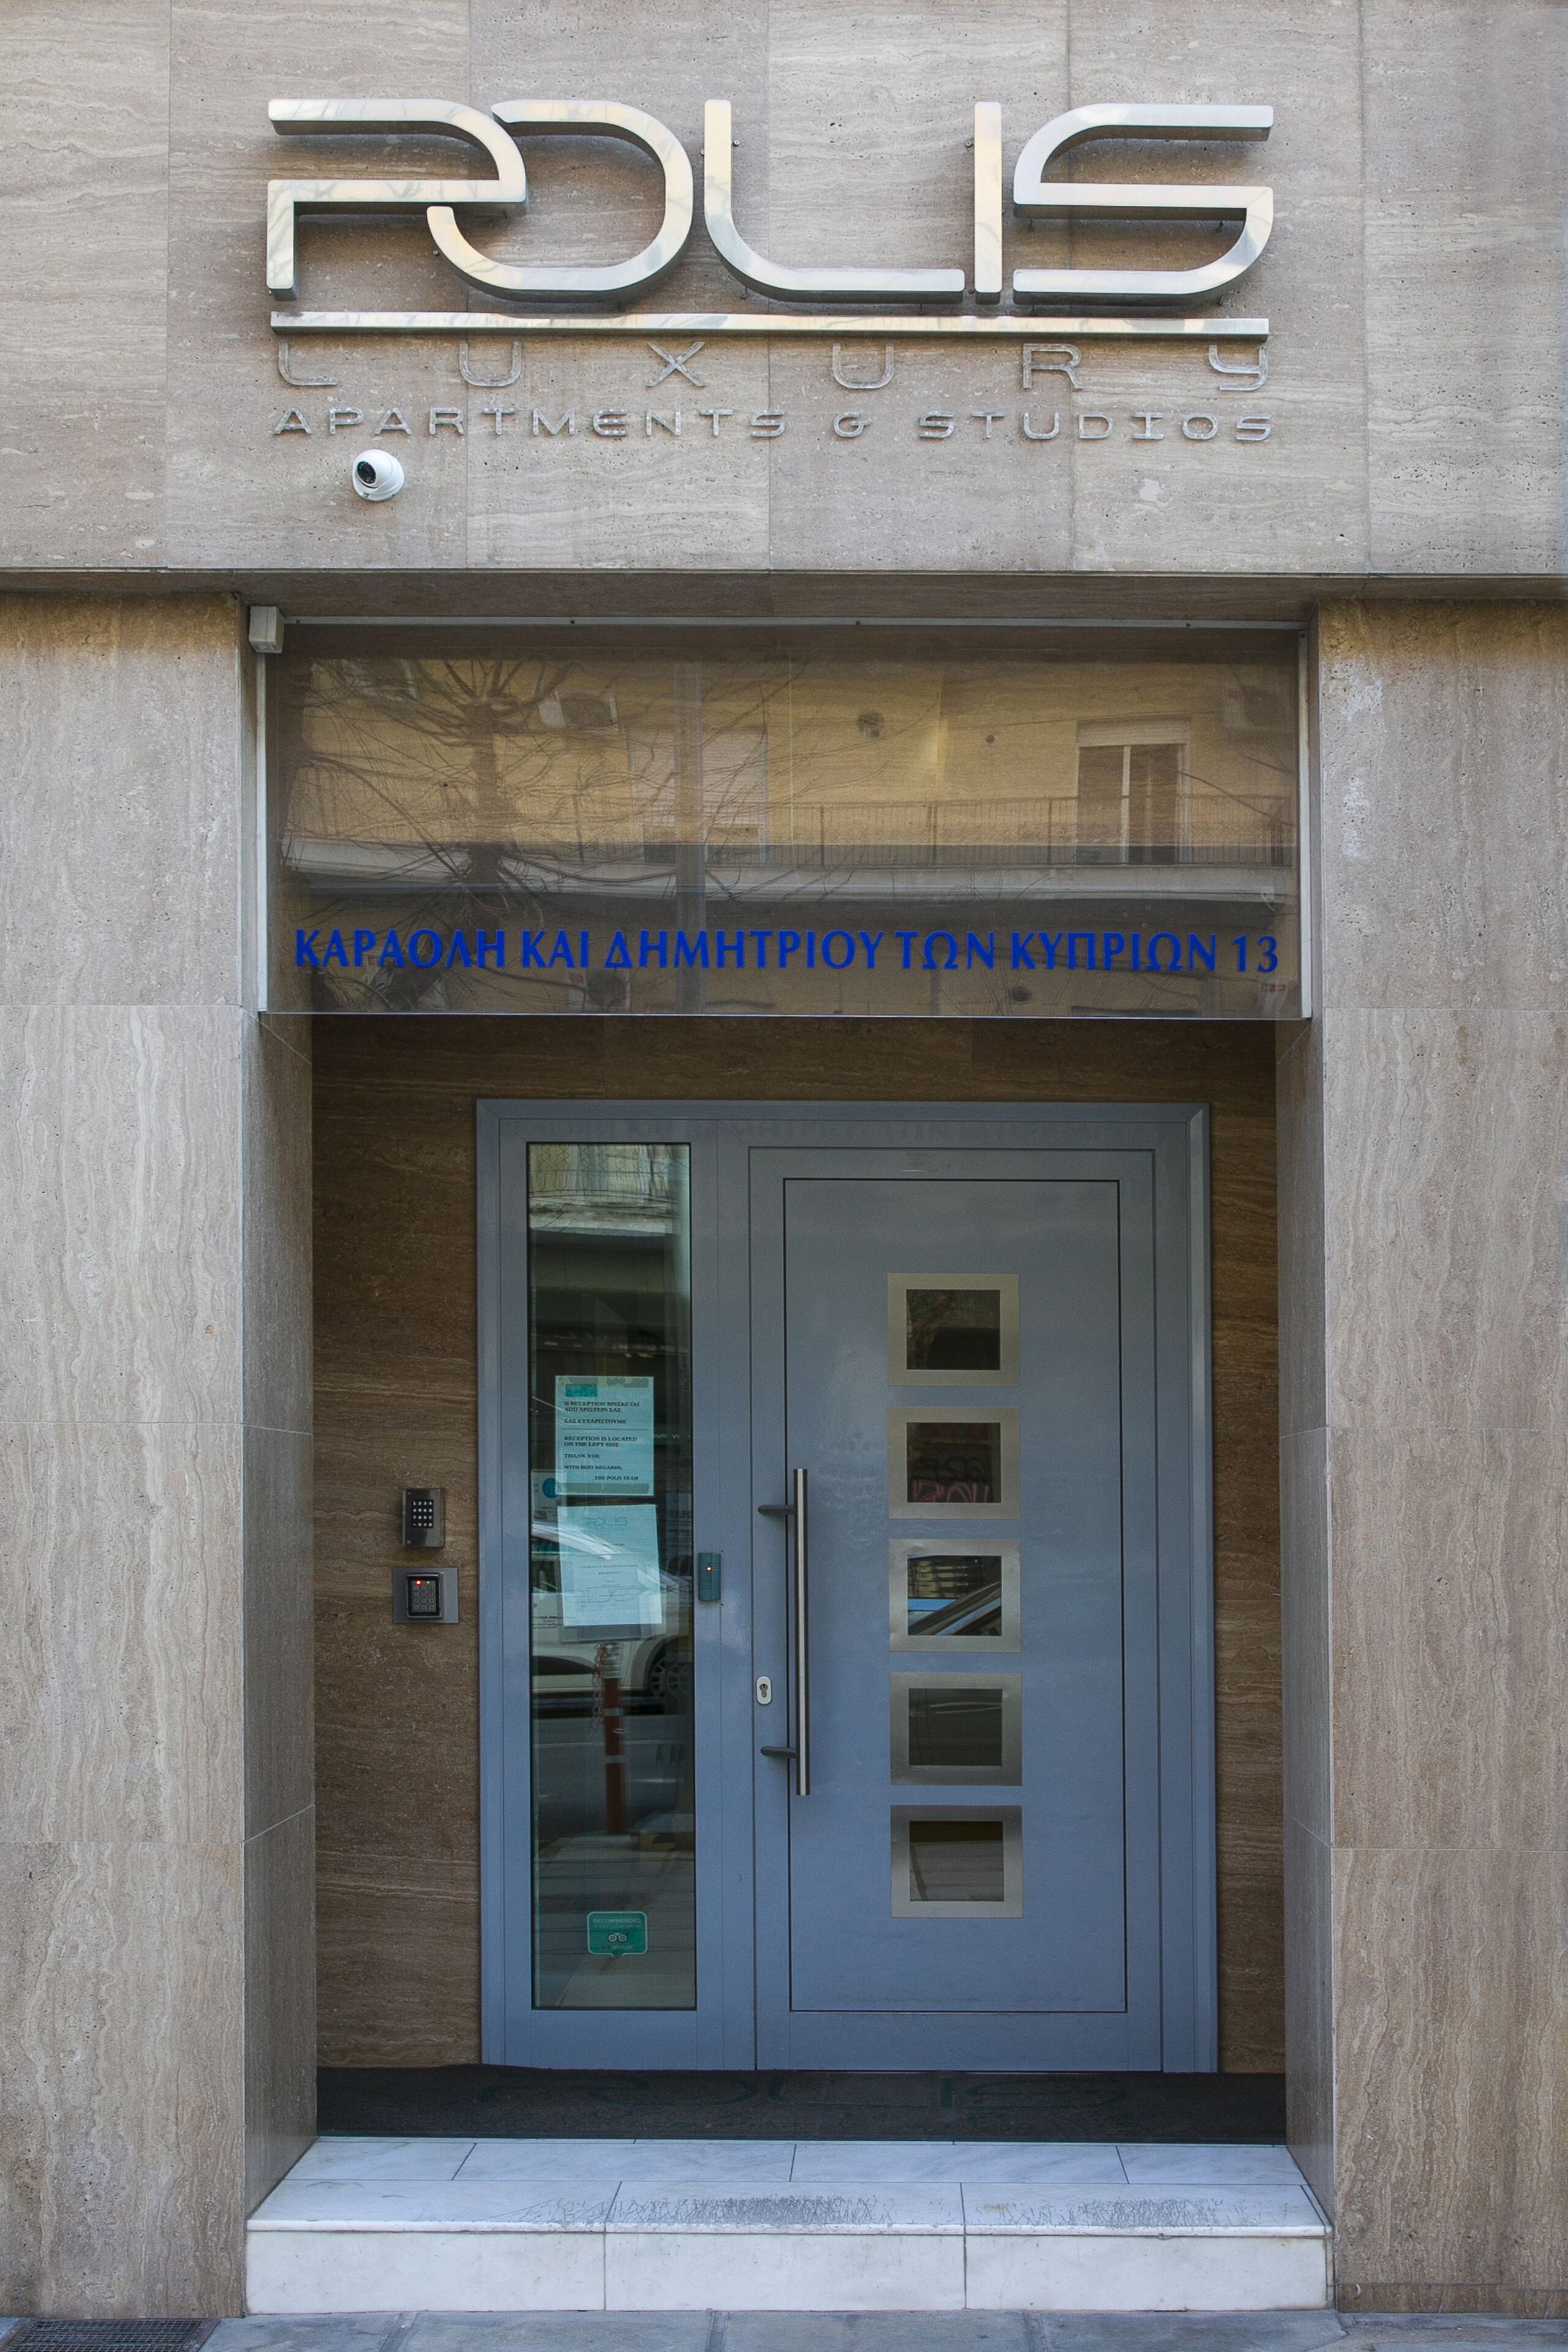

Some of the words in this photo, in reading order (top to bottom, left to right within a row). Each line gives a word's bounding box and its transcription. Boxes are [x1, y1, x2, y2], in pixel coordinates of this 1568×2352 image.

[267, 99, 1275, 304] POLIS
[278, 341, 1268, 392] LUXURY
[273, 407, 786, 438] APARTMENTS
[919, 411, 1272, 441] STUDIOS
[296, 929, 505, 968] ΚΑΡΑΟΛΗ
[522, 930, 589, 968] ΚΑΙ
[605, 930, 883, 969] ΔΗΜΗΤΡΙΟΥ
[895, 931, 995, 970] ΤΩΝ
[1011, 932, 1216, 971] ΚΥΠΡΙΩΝ
[1234, 935, 1278, 973] 13
